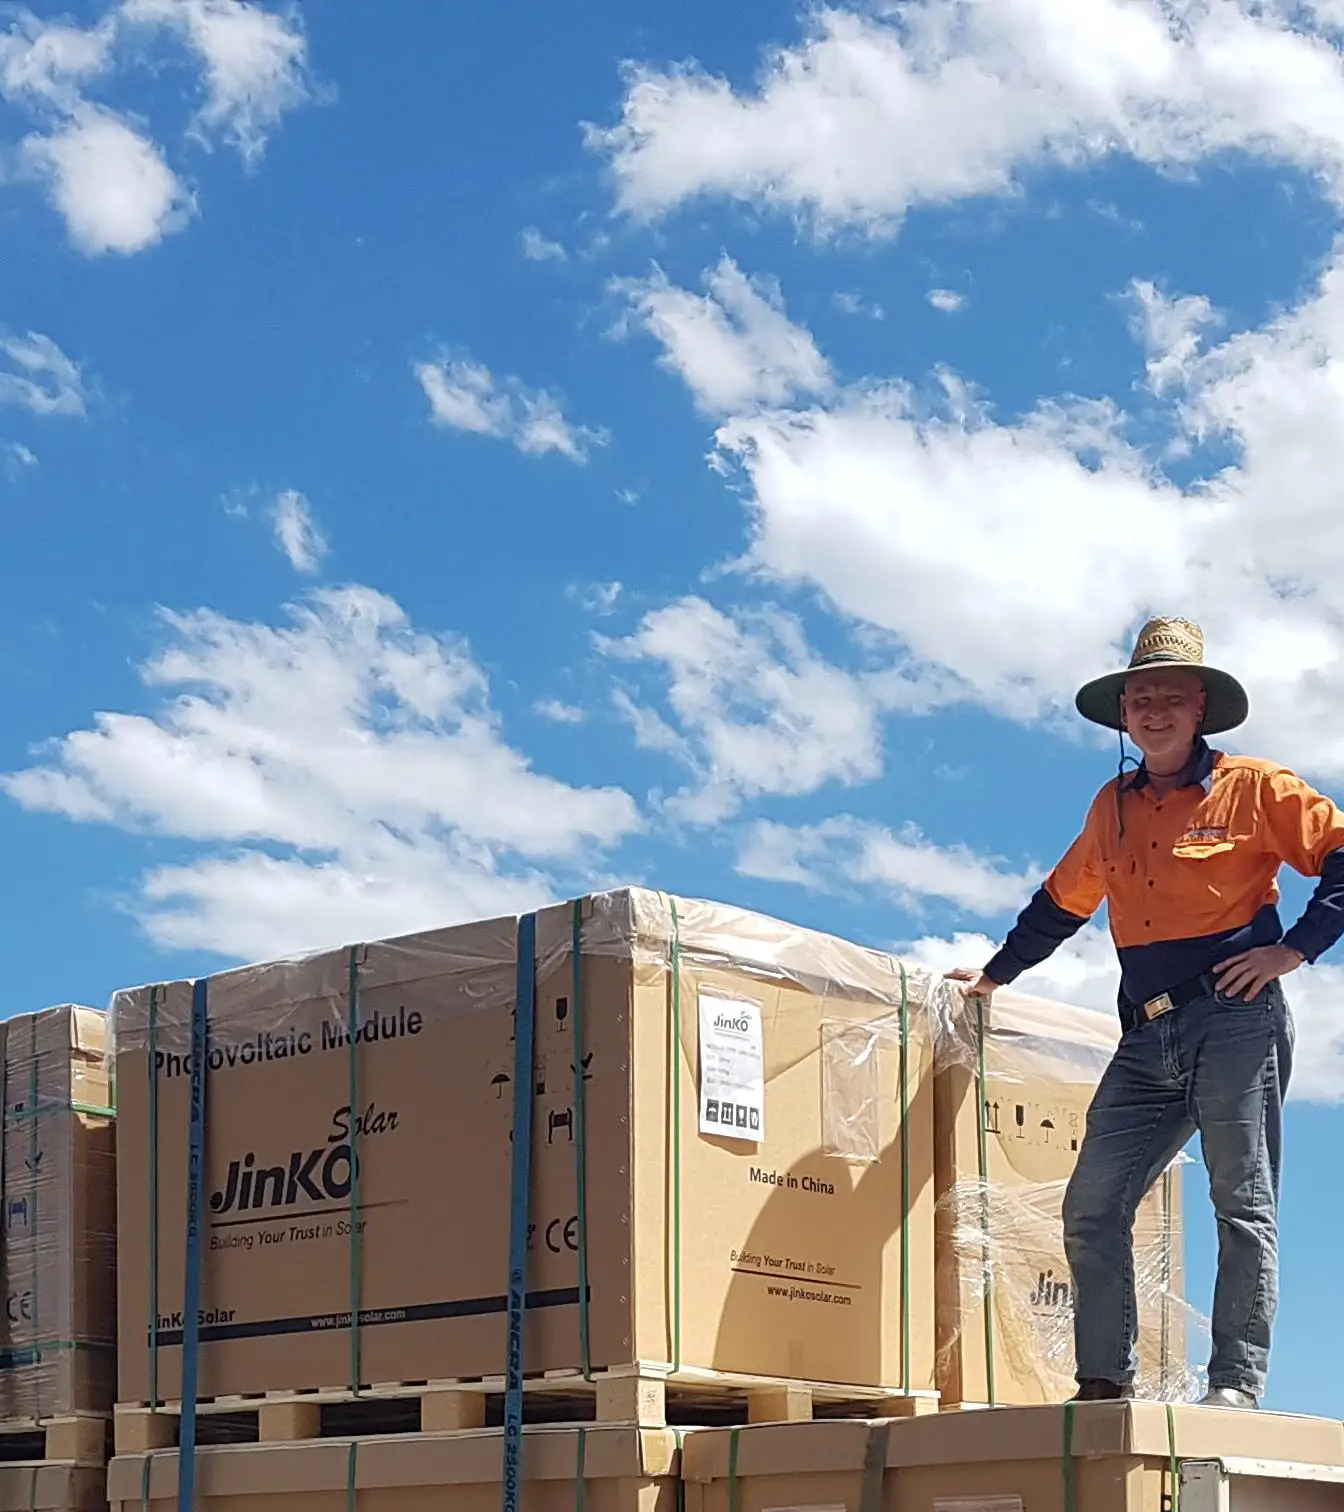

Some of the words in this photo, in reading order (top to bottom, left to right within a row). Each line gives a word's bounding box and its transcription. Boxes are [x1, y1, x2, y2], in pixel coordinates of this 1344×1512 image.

[713, 1013, 749, 1033] JinKO
[149, 1027, 312, 1080] Phoovoltaic
[321, 1006, 423, 1051] Module
[209, 1144, 360, 1214] JinKO
[749, 1166, 784, 1187] Made
[787, 1172, 798, 1189] in
[801, 1176, 835, 1195] China
[209, 1236, 254, 1250] Building
[258, 1230, 286, 1245] Your
[289, 1225, 321, 1241] Trust
[322, 1225, 333, 1238] in
[336, 1220, 367, 1236] Soar
[763, 1254, 783, 1269] Your
[785, 1258, 806, 1273] Trust
[767, 1286, 852, 1306] www.jinkosolar.com
[311, 1309, 406, 1328] www.jinksolar.com
[508, 1288, 523, 1392] ANCRA
